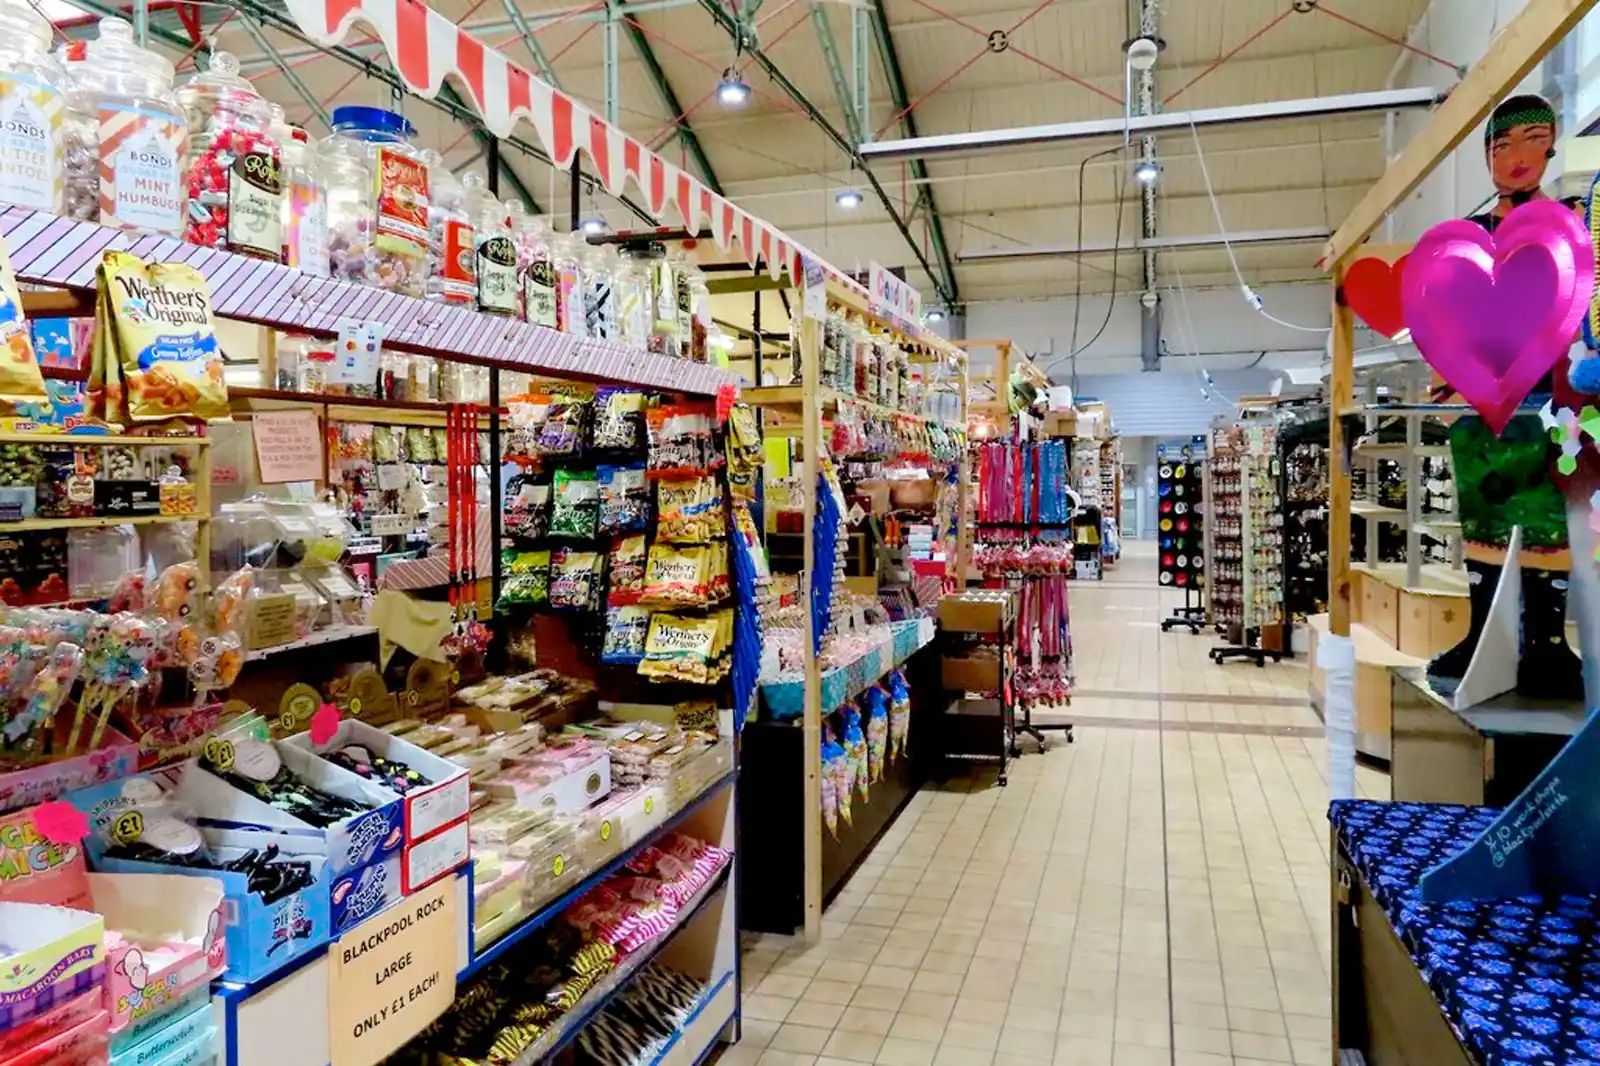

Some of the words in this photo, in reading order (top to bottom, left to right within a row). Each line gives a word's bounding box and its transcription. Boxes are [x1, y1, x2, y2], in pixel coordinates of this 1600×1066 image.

[130, 151, 173, 169] BONDS
[134, 177, 170, 195] MINT
[118, 191, 180, 212] HUMBUGS
[115, 275, 206, 309] Werther's
[146, 300, 208, 327] Original
[119, 816, 139, 836] £1
[343, 916, 413, 964] BLACKPOOL
[416, 895, 445, 921] ROCK
[4, 962, 67, 1004] MACAROON
[375, 952, 413, 985] LARGE
[353, 1008, 388, 1038] ONLY
[391, 995, 405, 1014] £1
[408, 971, 440, 1002] EACH!
